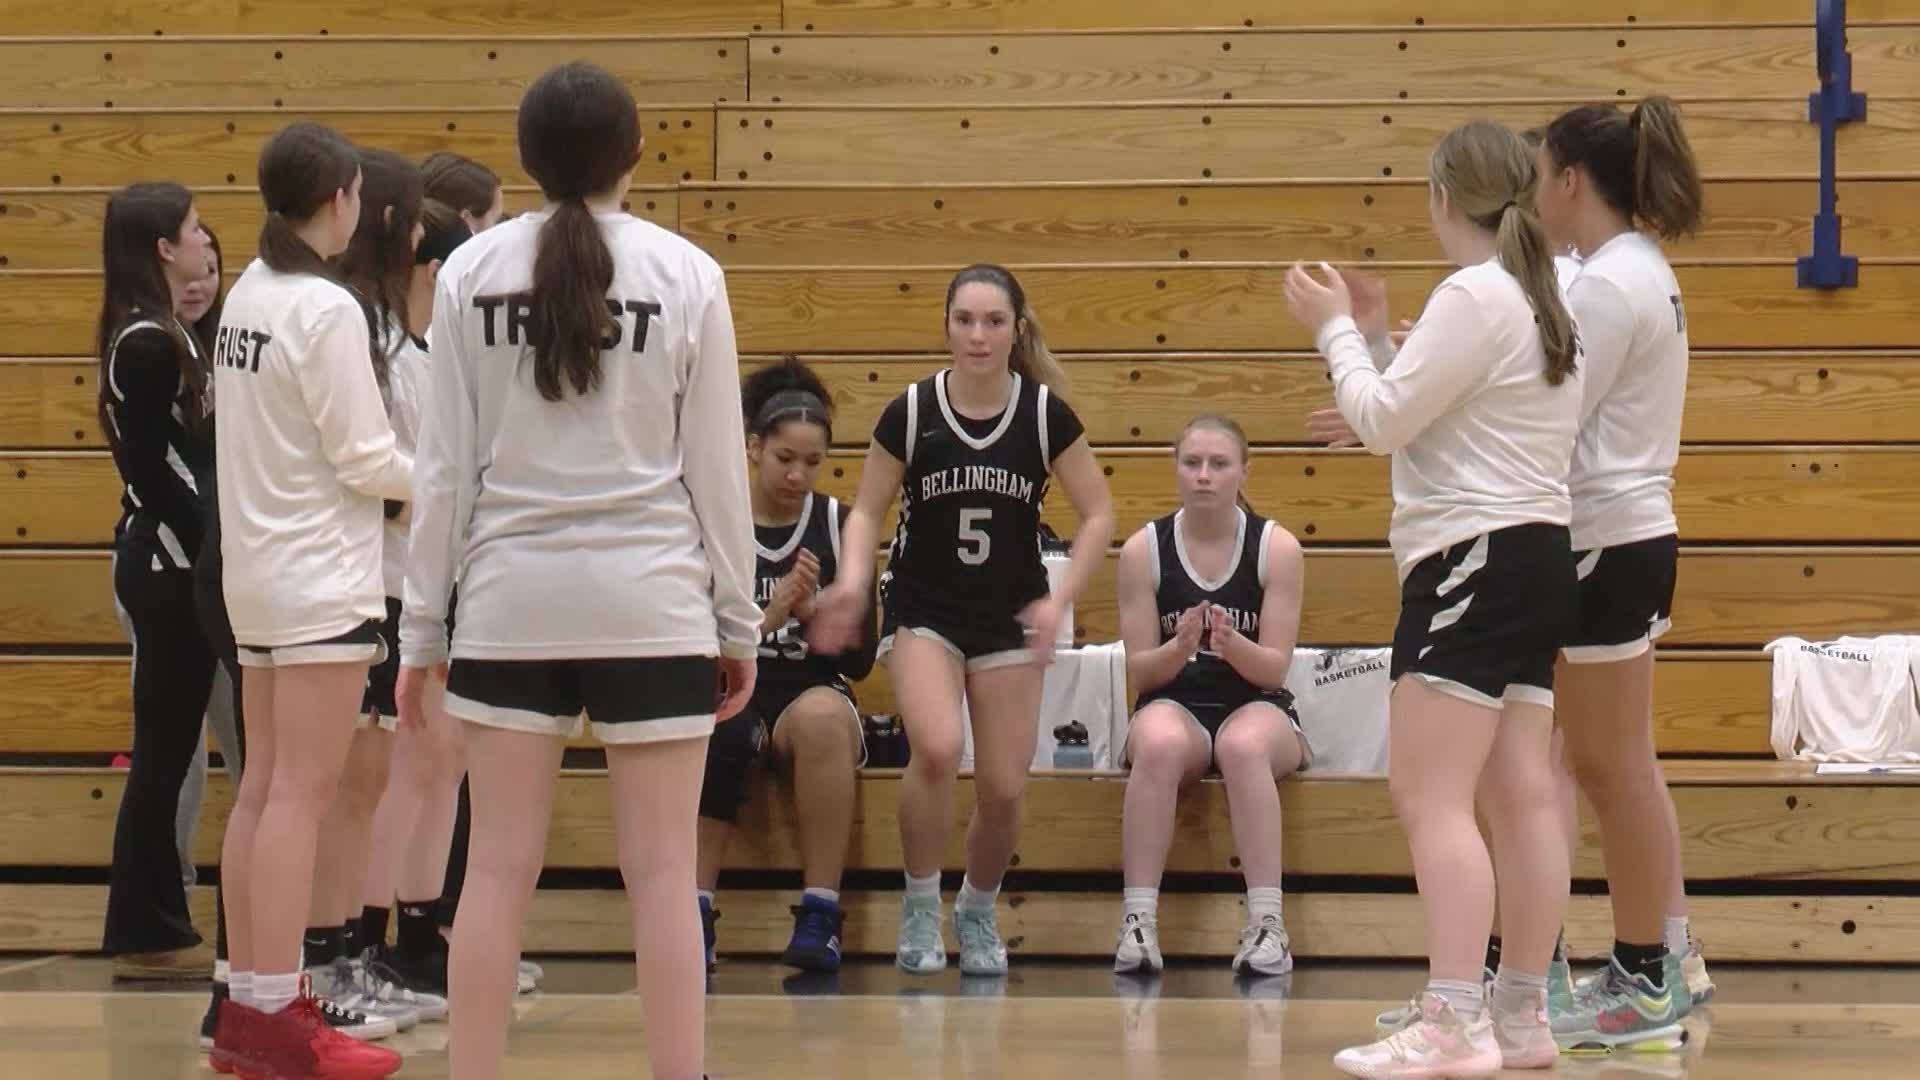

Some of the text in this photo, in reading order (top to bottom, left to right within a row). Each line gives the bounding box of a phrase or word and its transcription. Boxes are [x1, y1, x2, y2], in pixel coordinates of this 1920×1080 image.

[473, 292, 662, 353] TRST
[216, 326, 272, 374] RUST
[921, 465, 1033, 503] BELLINGHAM
[957, 508, 993, 565] 5
[1314, 661, 1386, 687] BASKETBALL
